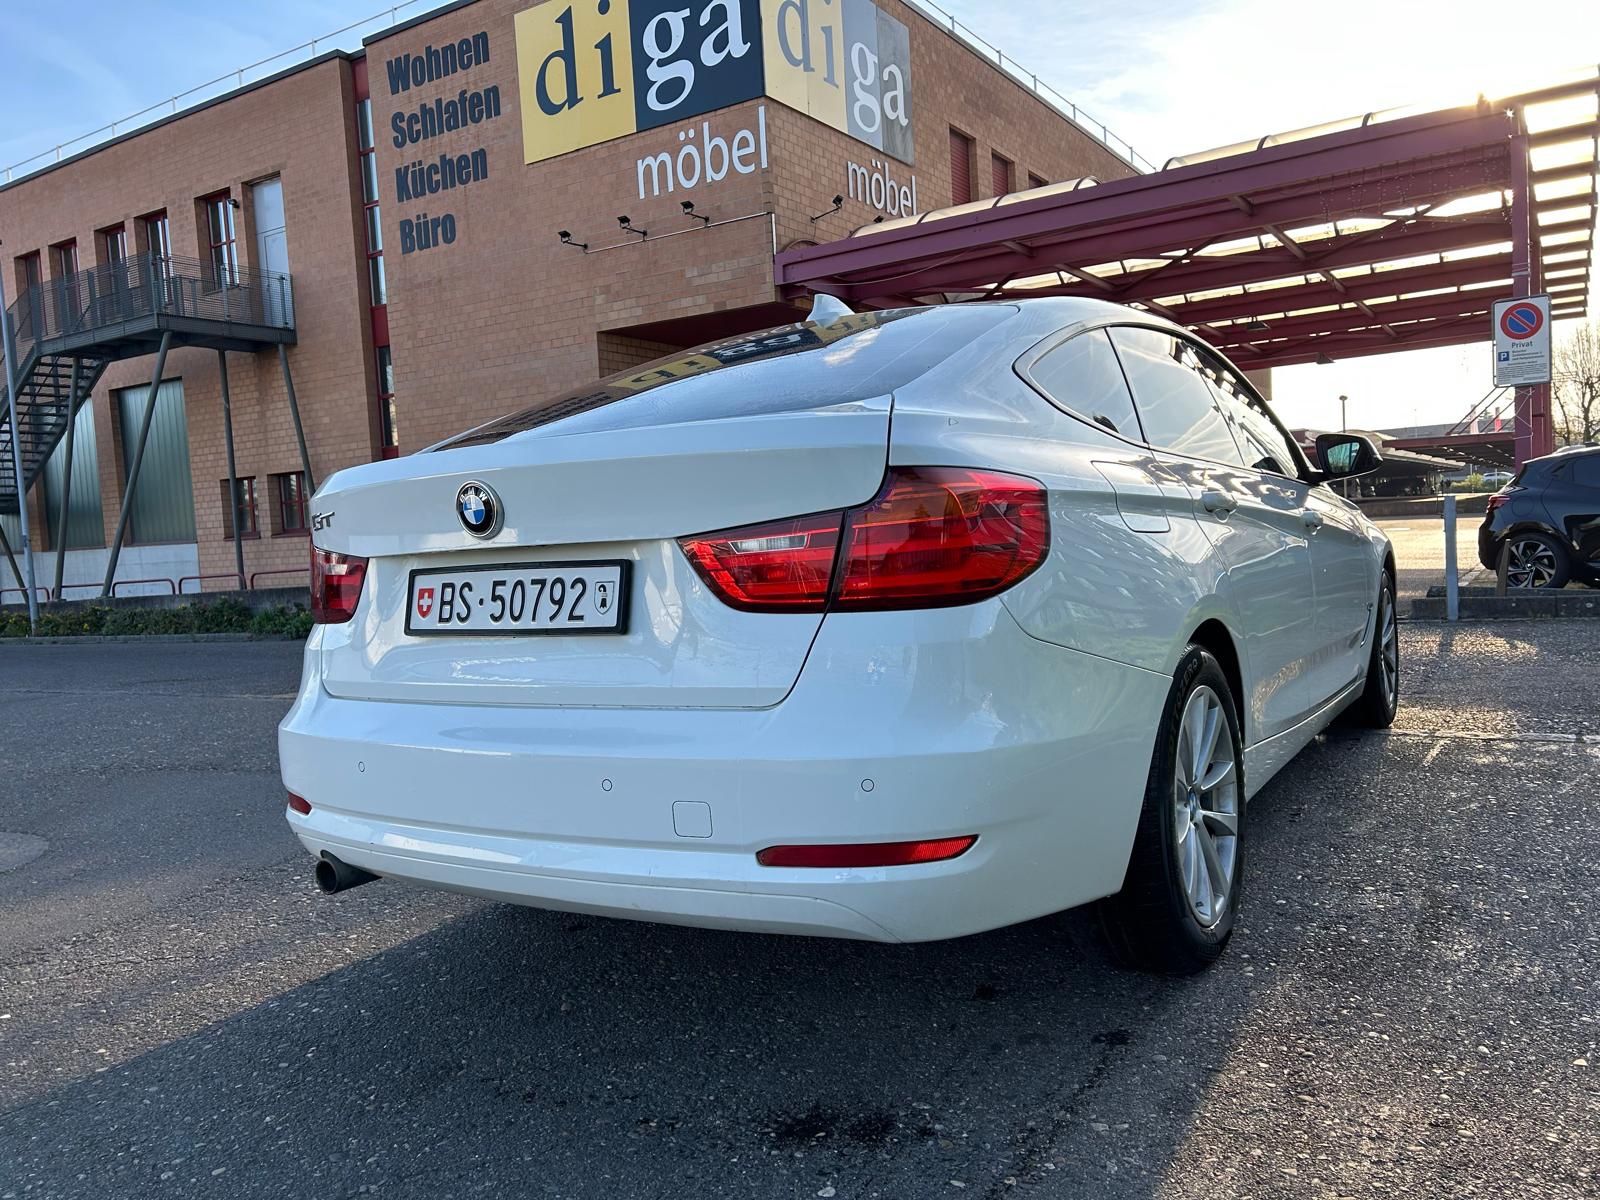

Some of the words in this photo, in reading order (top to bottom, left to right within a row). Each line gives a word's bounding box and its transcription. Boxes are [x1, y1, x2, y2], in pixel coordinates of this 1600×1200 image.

[386, 31, 490, 96] Wohnen
[535, 0, 751, 116] diga
[776, 0, 908, 133] diga
[391, 82, 501, 150] Schlafen
[395, 147, 488, 204] Küchen
[637, 105, 768, 200] möbel
[847, 159, 918, 217] möbel
[400, 212, 457, 255] Büro
[1511, 341, 1533, 349] Privat
[460, 486, 488, 503] BMW
